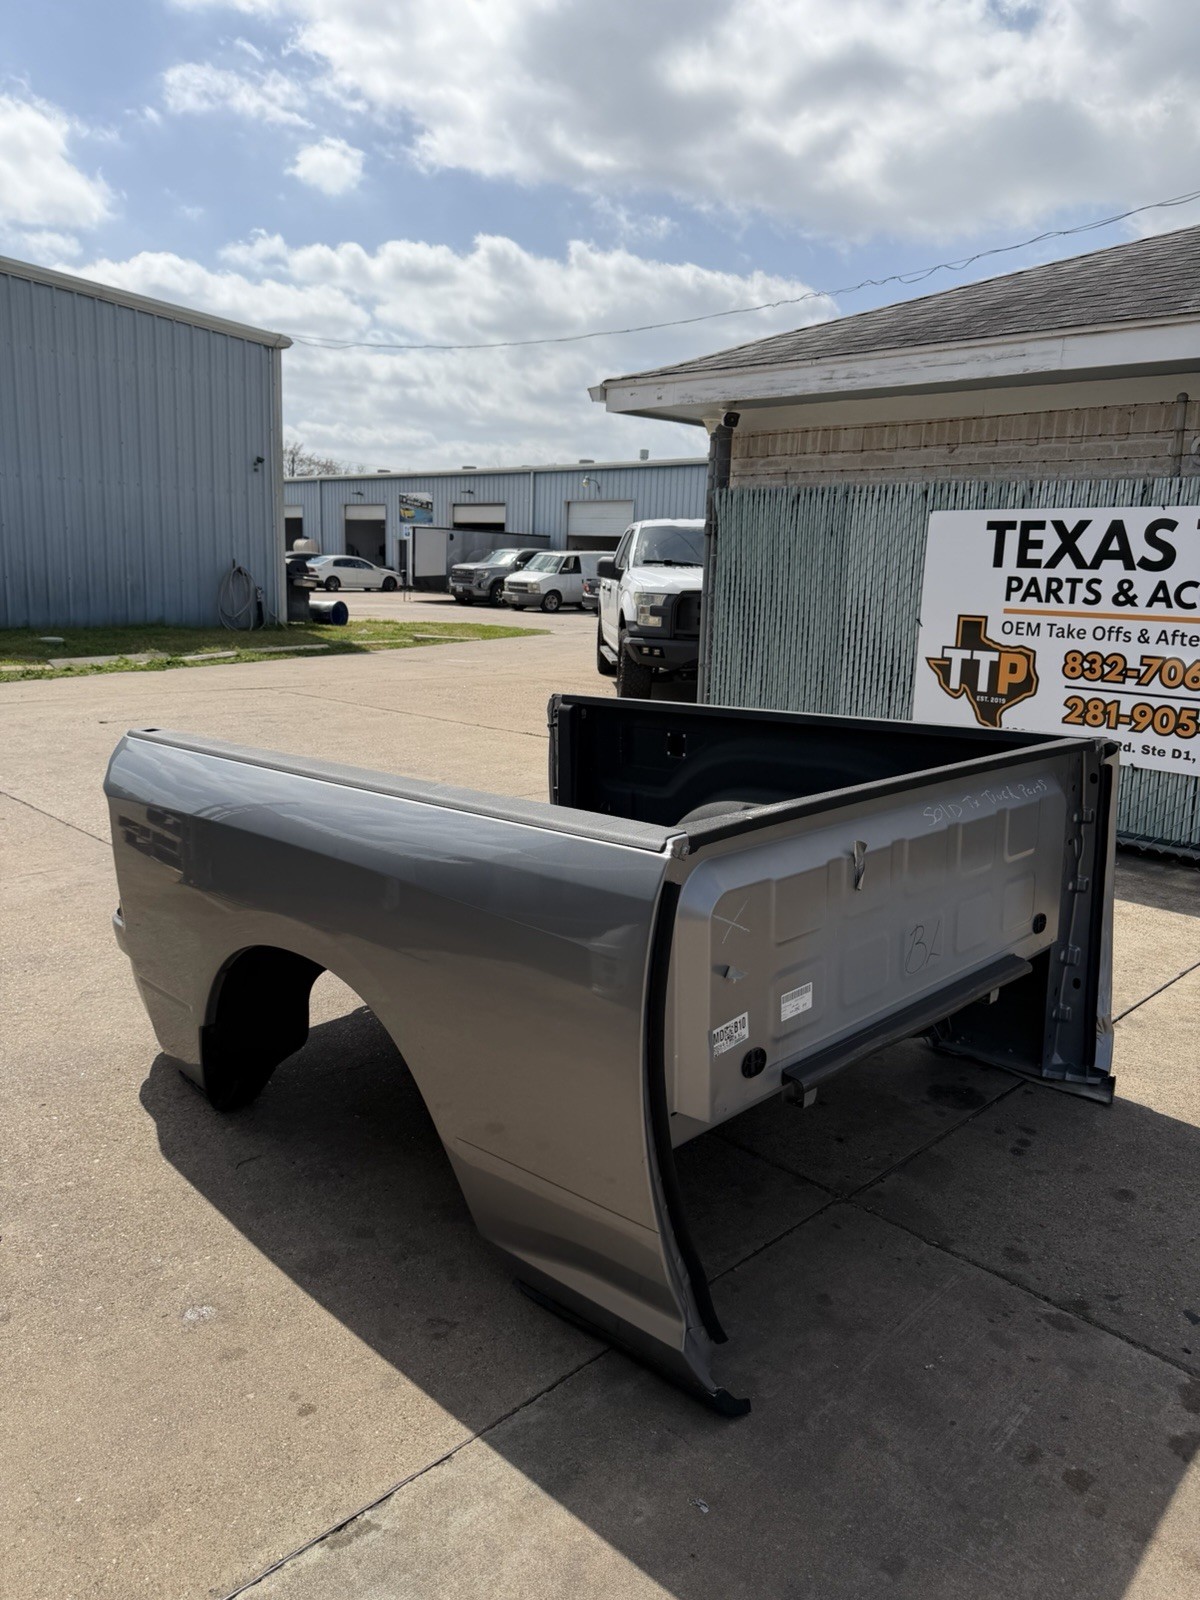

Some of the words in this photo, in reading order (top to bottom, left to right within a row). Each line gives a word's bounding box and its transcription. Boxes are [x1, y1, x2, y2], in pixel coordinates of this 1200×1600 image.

[986, 518, 1179, 572] TEXAS
[1005, 576, 1102, 606] PARTS
[1111, 578, 1139, 607] &
[1001, 620, 1041, 637] OEM
[1047, 623, 1087, 640] Take
[1092, 626, 1132, 643] Offs
[1137, 628, 1151, 645] &
[943, 647, 1028, 695] TTP
[1062, 695, 1200, 739] 281-905
[1141, 744, 1166, 757] Ste
[1171, 749, 1196, 764] D1,
